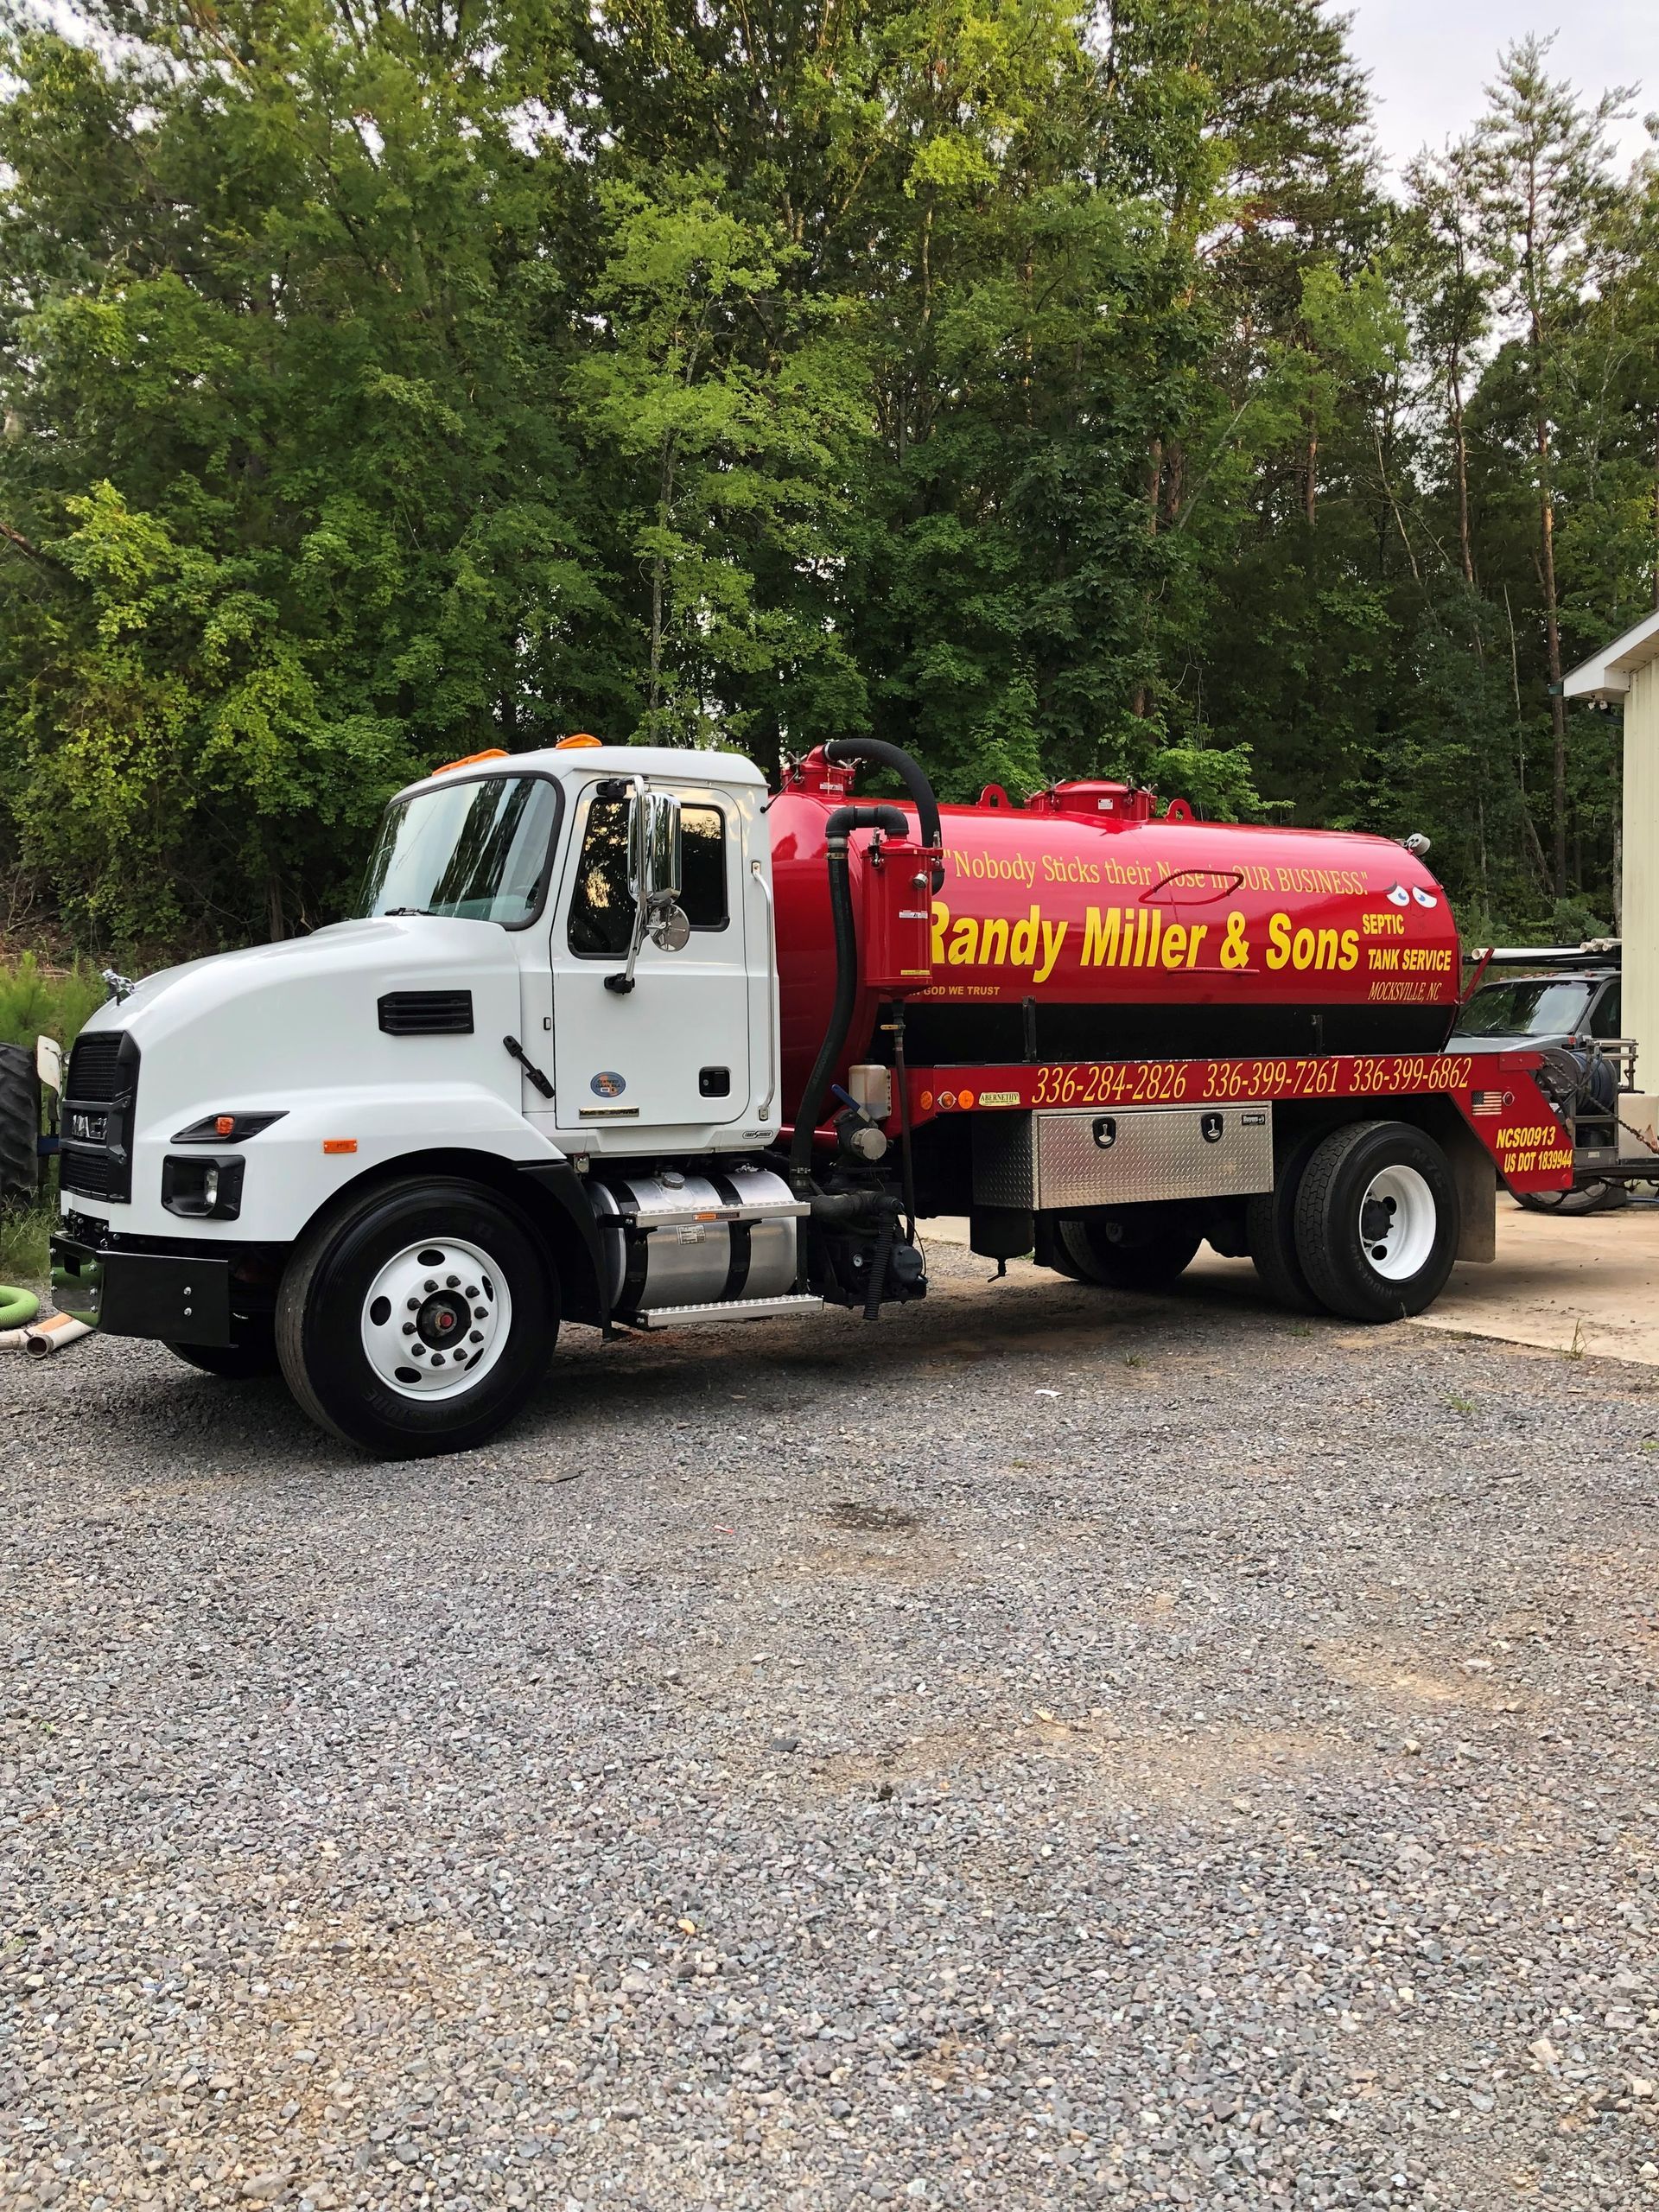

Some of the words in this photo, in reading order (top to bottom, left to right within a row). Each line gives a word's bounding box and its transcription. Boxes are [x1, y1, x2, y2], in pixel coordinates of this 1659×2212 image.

[943, 849, 1036, 889] "Nobody
[1041, 855, 1101, 885] Sticks
[1105, 857, 1152, 886] their
[1155, 861, 1205, 888] Nose
[1208, 864, 1230, 889] in
[1232, 865, 1275, 892] OUR
[1276, 867, 1369, 895] BUSINESS."
[1362, 913, 1405, 935] SEPTIC
[931, 901, 1068, 982] Randy
[1080, 906, 1208, 969] Miller
[1219, 911, 1249, 969] &
[1266, 912, 1360, 970] Sons
[1368, 949, 1400, 970] TANK
[1402, 949, 1452, 971] SERVICE
[924, 986, 946, 995] GOD
[949, 986, 964, 995] WE
[967, 986, 1001, 995] TRUST
[1368, 982, 1426, 1002] MOCKSVILLE,
[1427, 982, 1442, 1001] NC
[1031, 1064, 1188, 1103] 336-284-2826
[1203, 1059, 1339, 1096] 336-399-7261
[1349, 1057, 1472, 1092] 336-399-6862
[1496, 1126, 1556, 1149] NCS00913
[1503, 1153, 1516, 1173] US
[1517, 1152, 1536, 1173] DOT
[1538, 1149, 1573, 1171] 1839944
